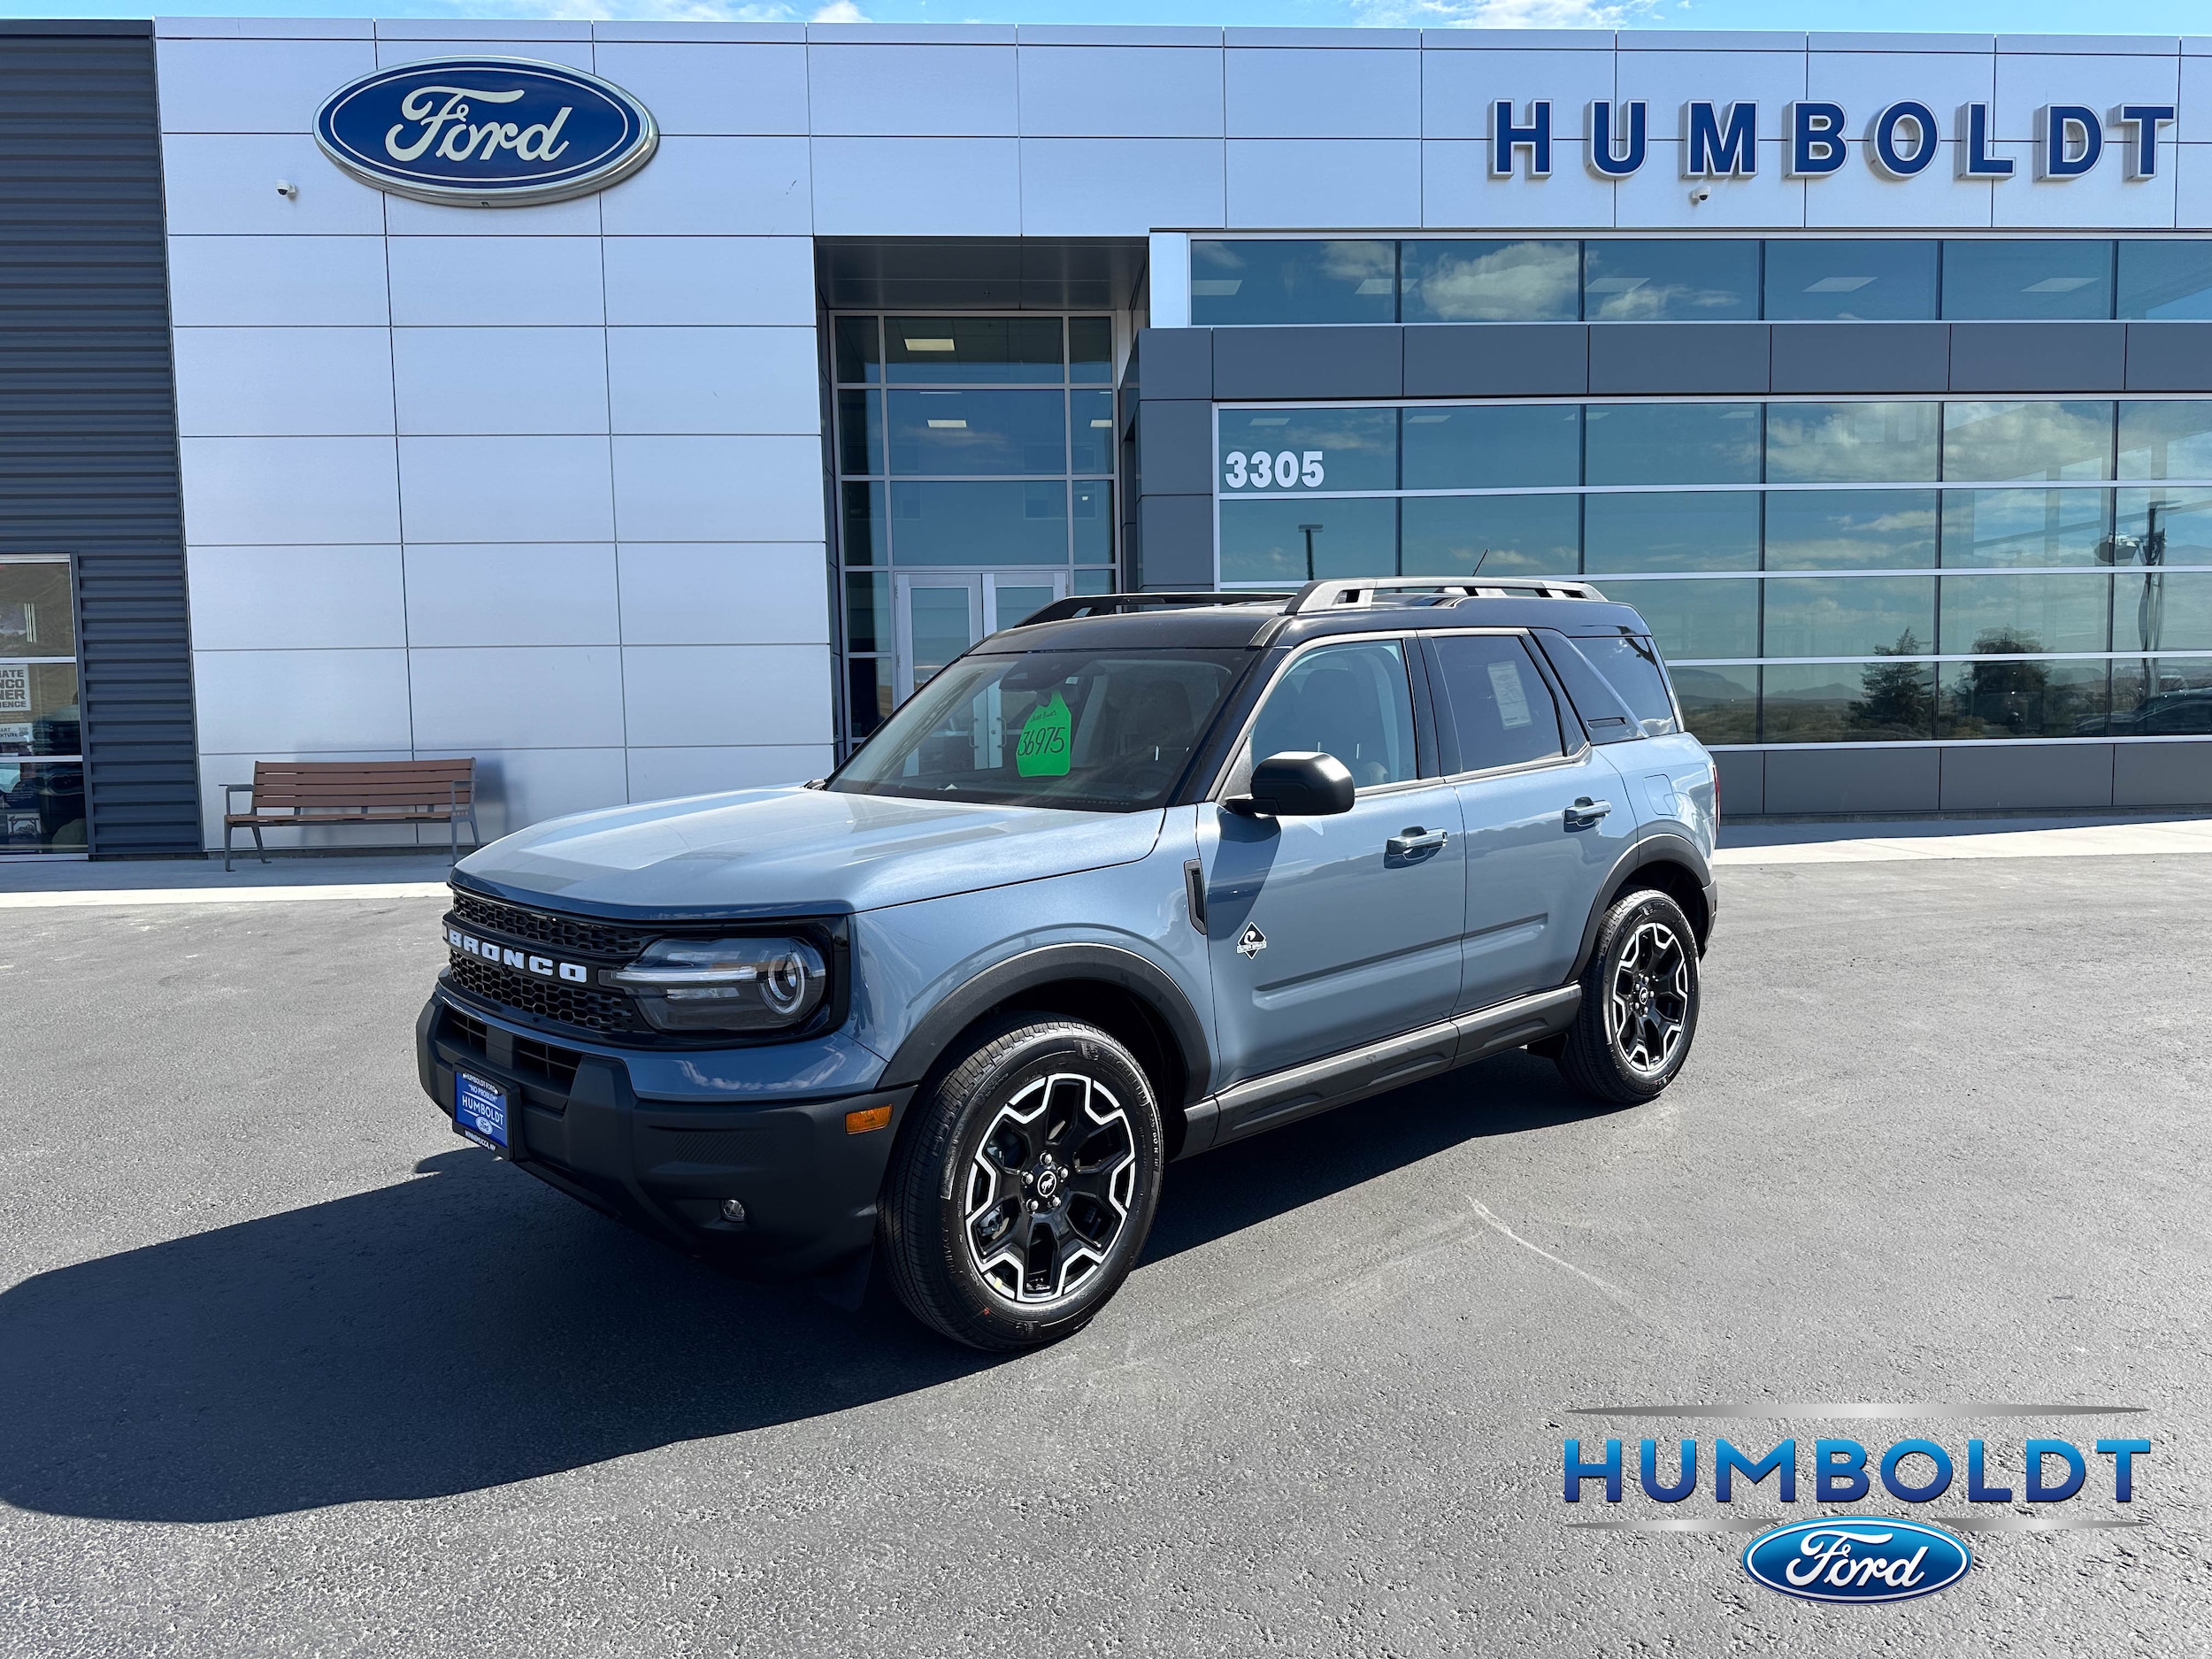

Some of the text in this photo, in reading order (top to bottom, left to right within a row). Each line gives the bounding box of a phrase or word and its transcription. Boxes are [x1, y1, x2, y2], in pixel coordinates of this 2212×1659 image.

[385, 86, 572, 162] Ford
[1489, 98, 2177, 180] HUMBOLDT
[1225, 450, 1325, 488] 3305
[1017, 726, 1066, 757] 36975
[449, 929, 587, 983] BRONCO
[462, 1095, 504, 1125] HUMBOLDT
